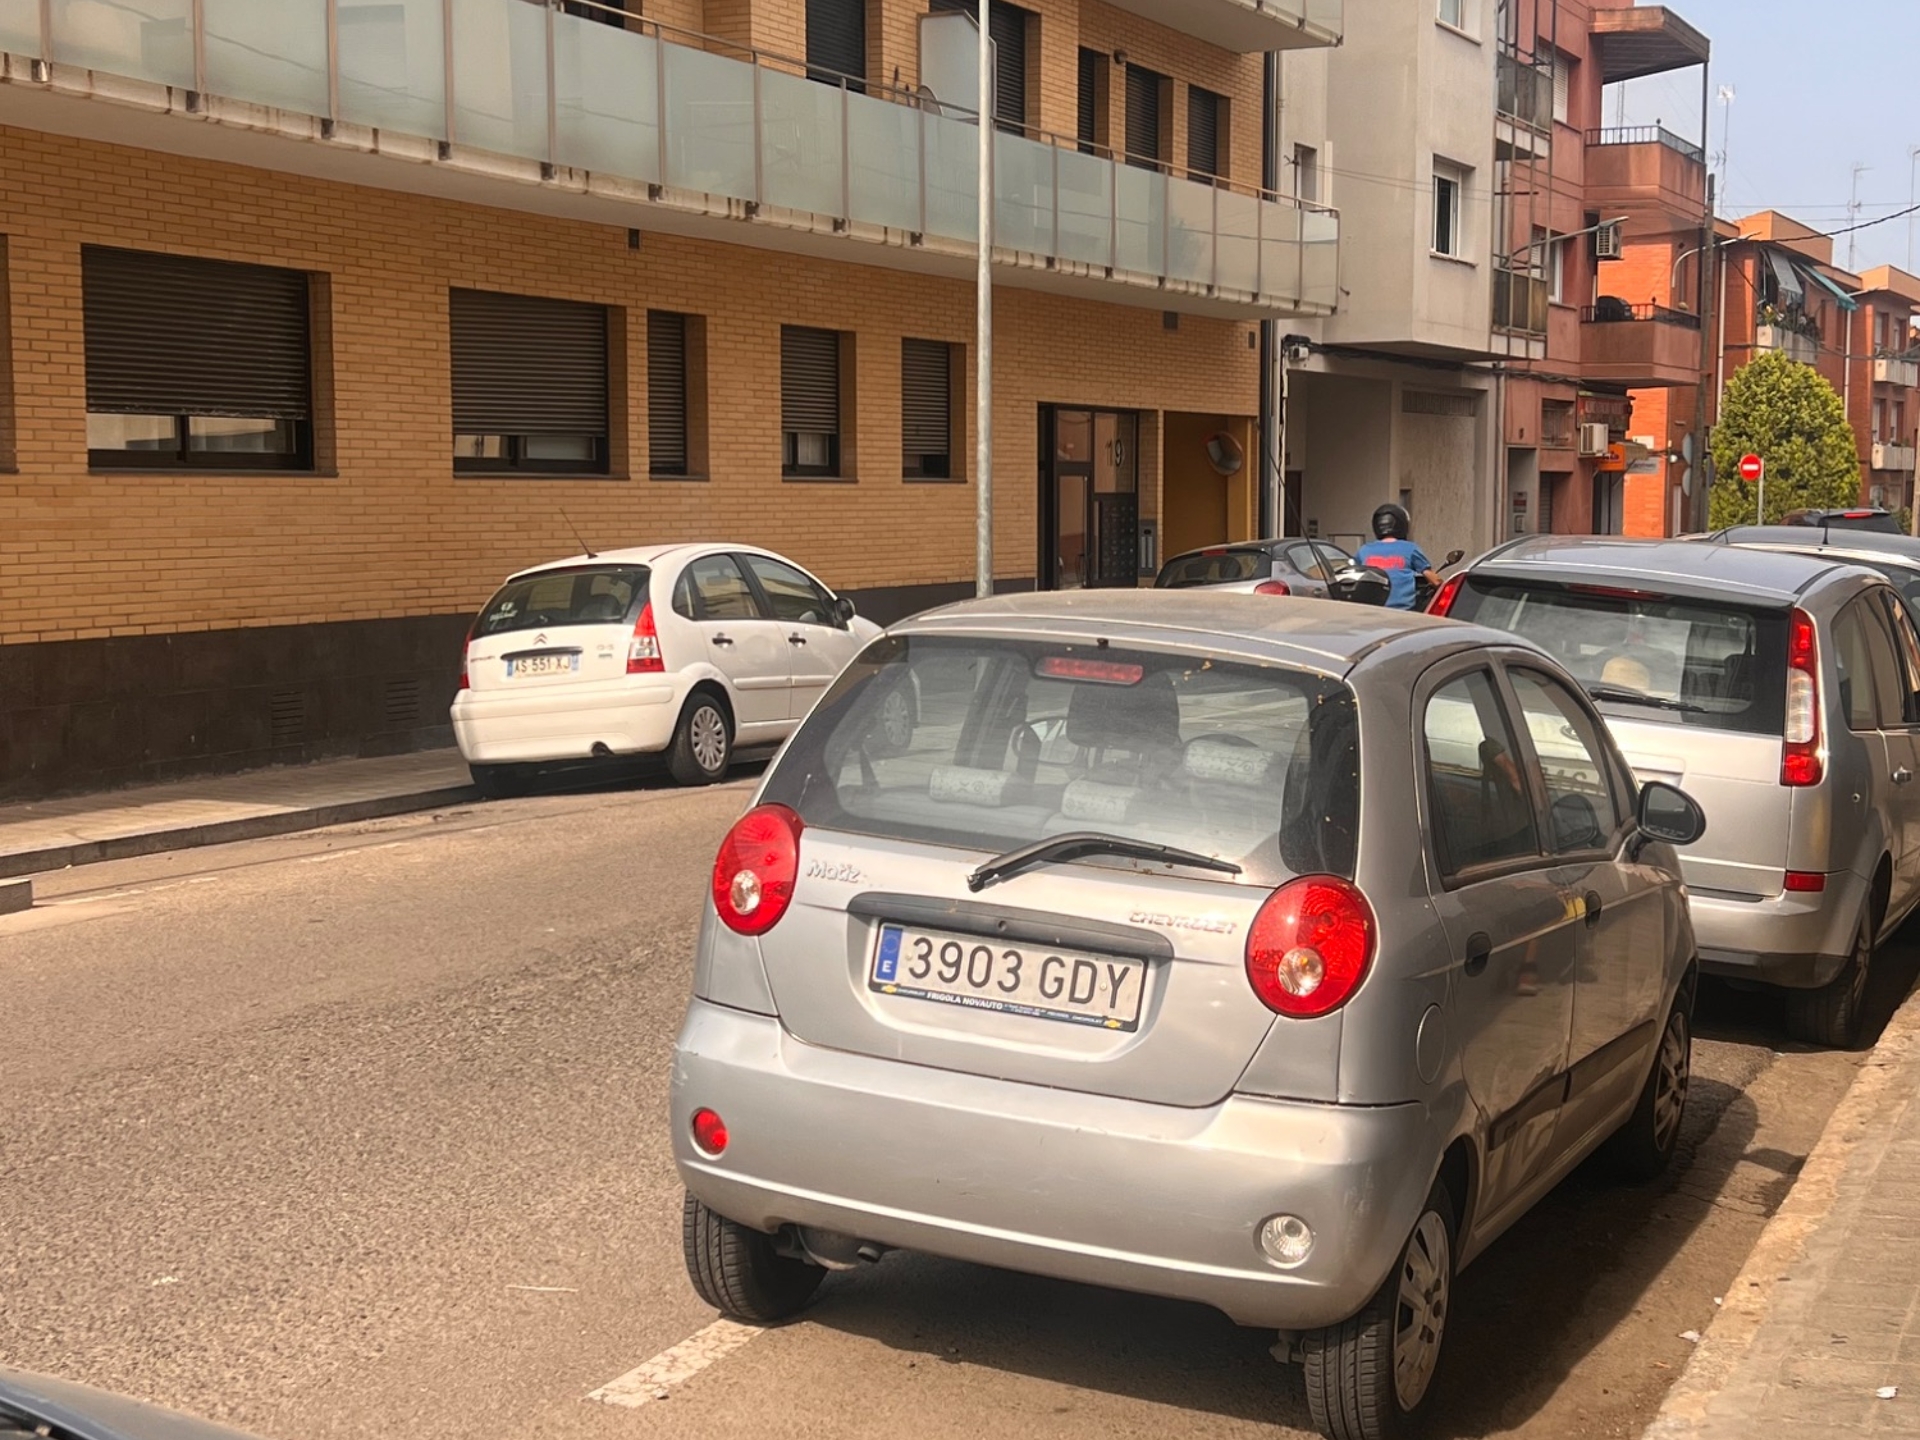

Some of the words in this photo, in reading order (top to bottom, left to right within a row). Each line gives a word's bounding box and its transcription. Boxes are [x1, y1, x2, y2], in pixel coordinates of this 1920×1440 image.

[806, 859, 862, 884] Matiz
[1128, 912, 1238, 935] CHEVROLET
[881, 960, 893, 973] E
[908, 937, 1023, 992] 3903
[1039, 956, 1131, 1009] GDY
[926, 991, 961, 1004] FRIGOLA
[962, 997, 1003, 1010] NOVAUTO
